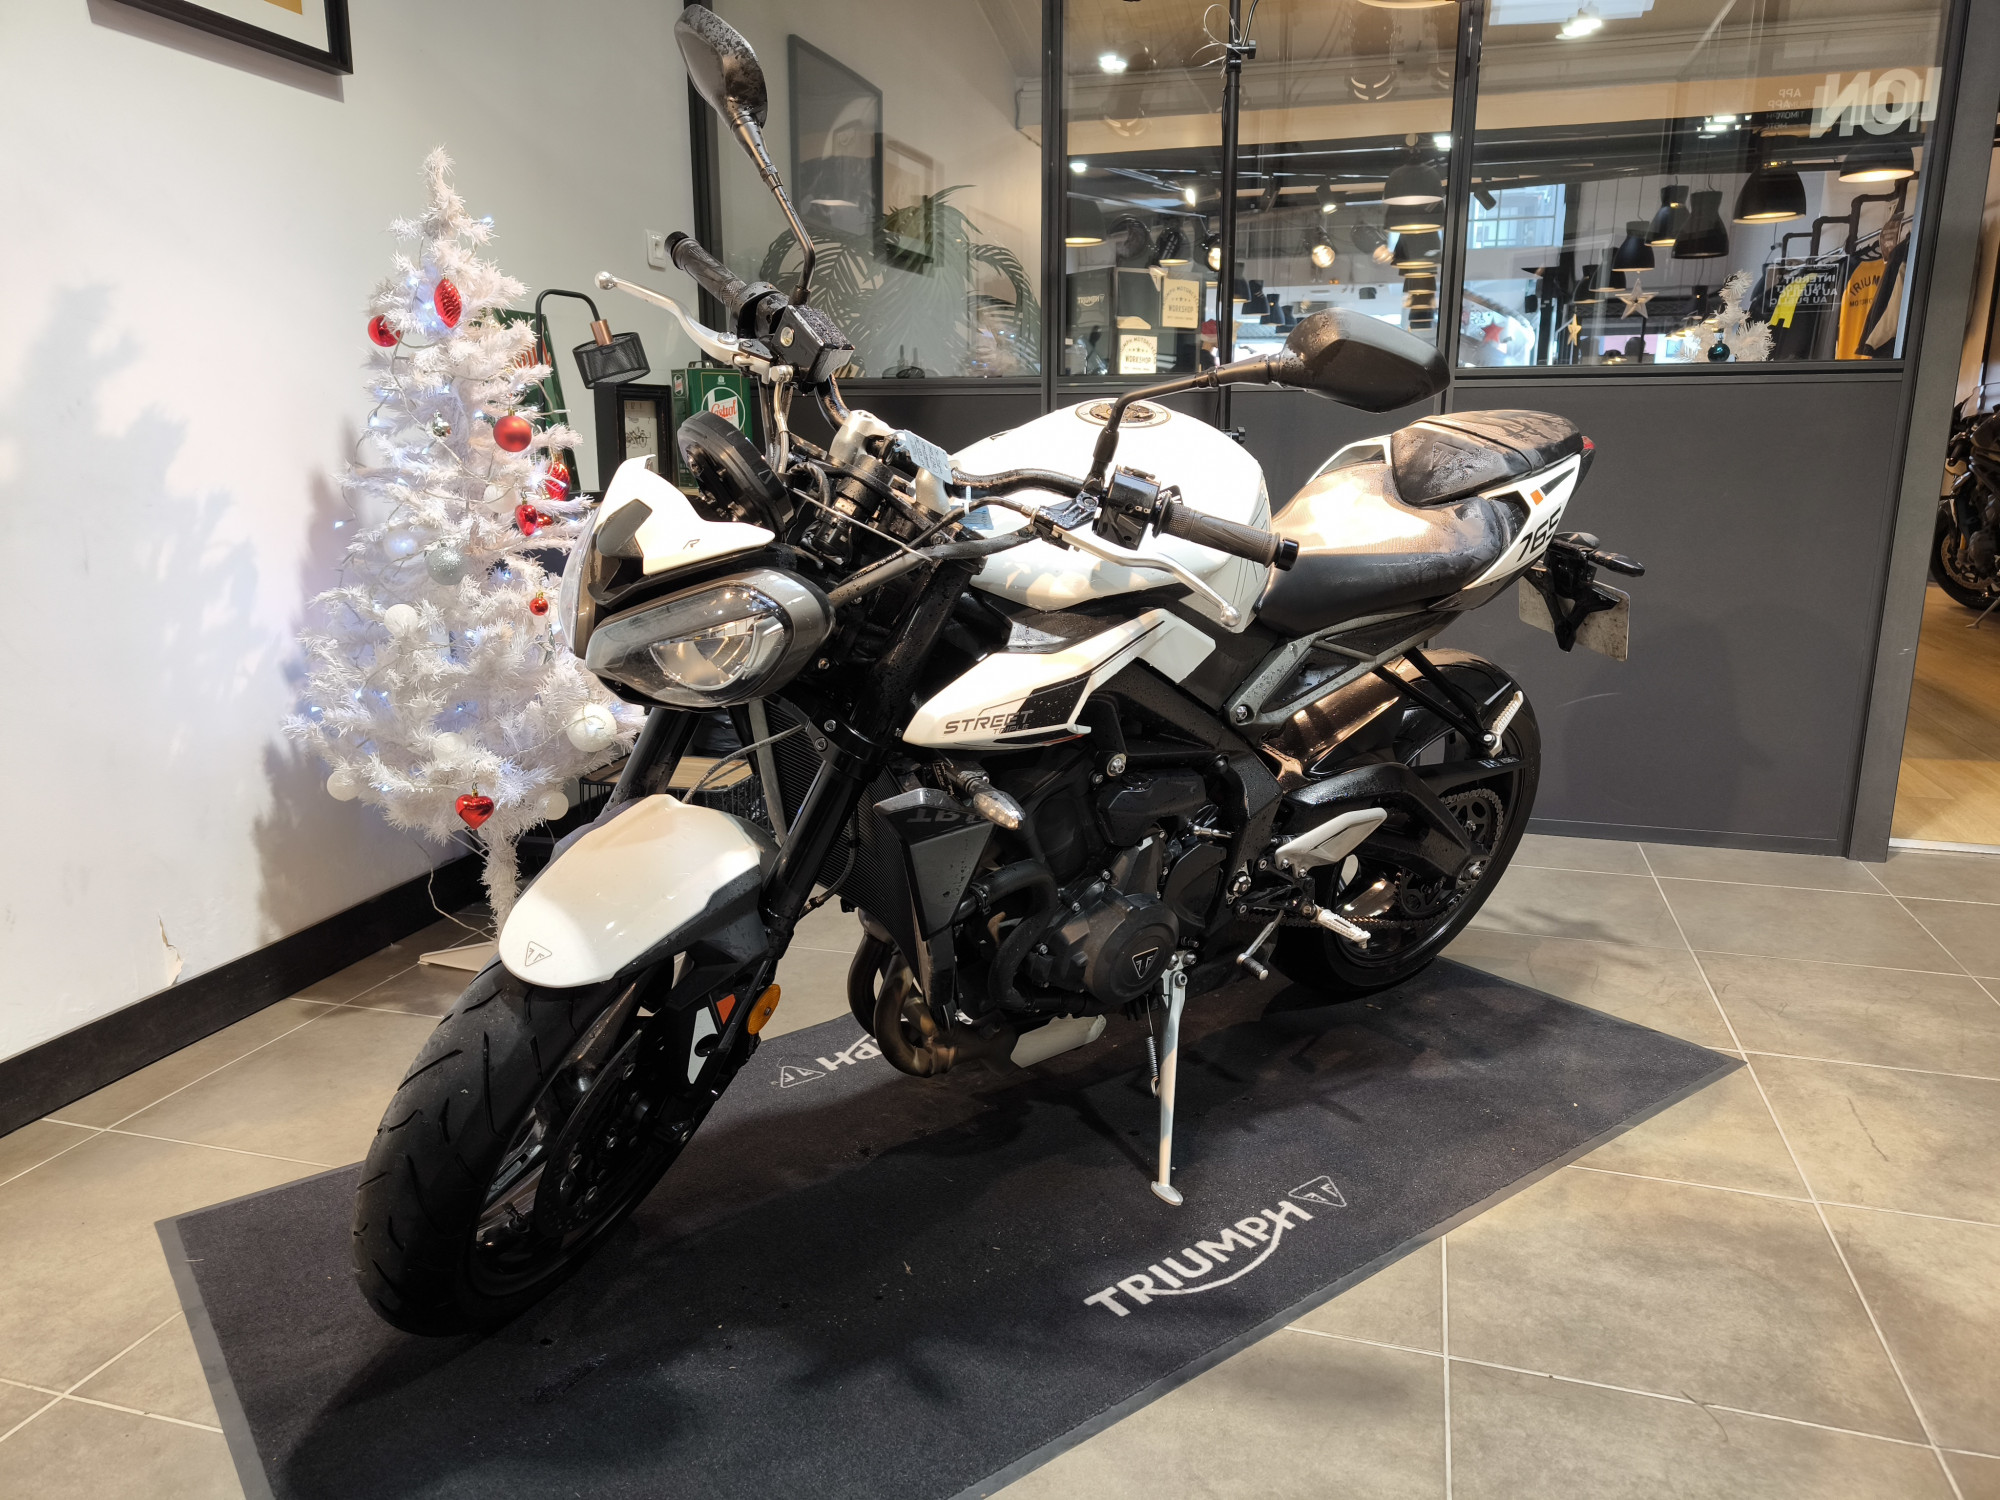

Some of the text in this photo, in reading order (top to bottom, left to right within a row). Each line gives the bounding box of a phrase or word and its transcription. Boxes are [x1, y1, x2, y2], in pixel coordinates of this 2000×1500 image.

[1517, 506, 1561, 562] 765
[943, 709, 1035, 735] STREET
[993, 723, 1030, 735] TRIPLE
[1083, 1200, 1314, 1317] TRIUMPH
